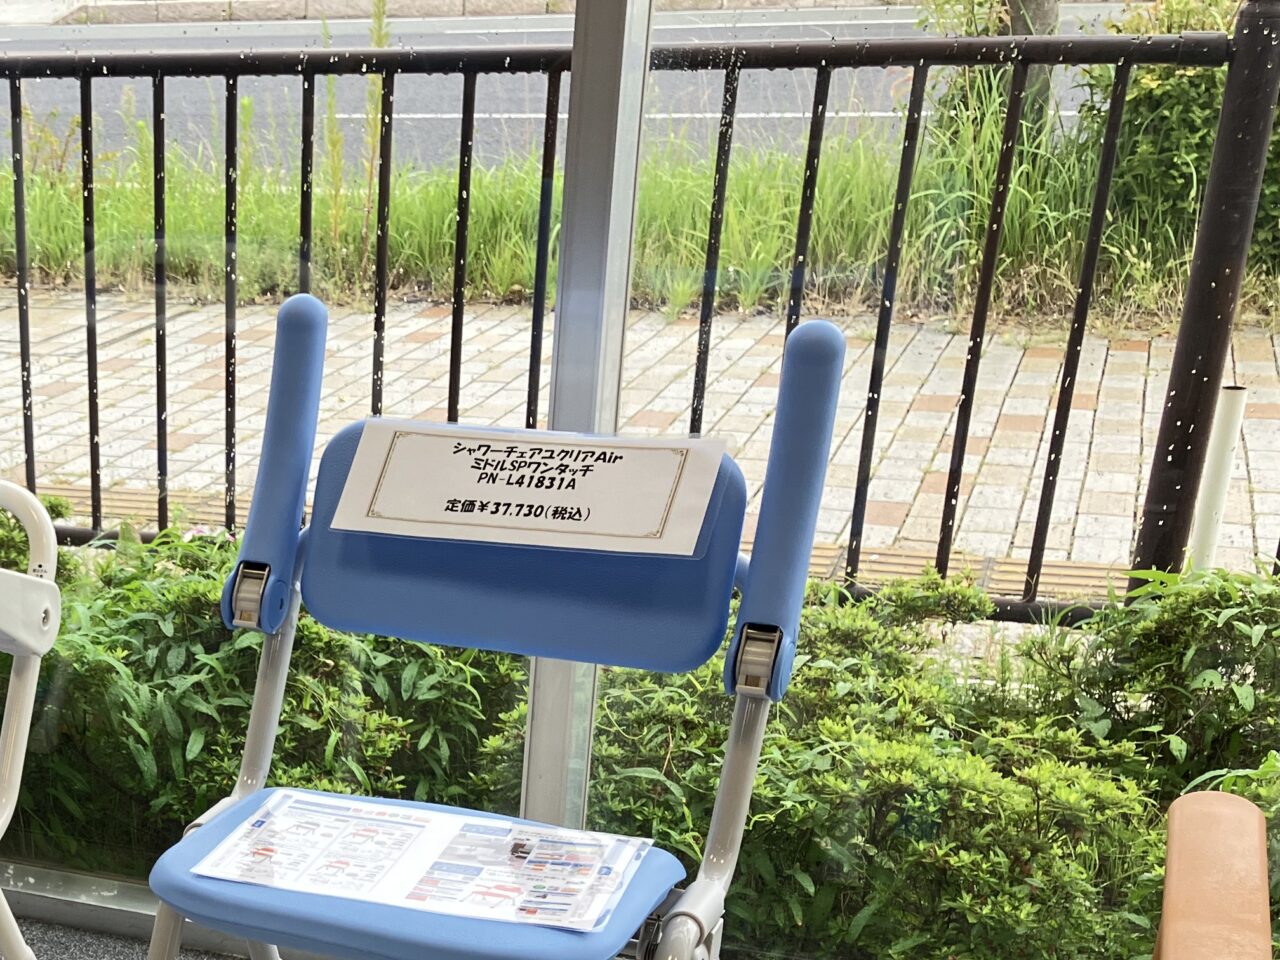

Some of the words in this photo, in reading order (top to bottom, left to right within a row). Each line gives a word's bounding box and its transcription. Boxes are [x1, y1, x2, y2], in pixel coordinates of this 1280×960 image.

[452, 442, 624, 464] シャワーチェアユクリアAir
[470, 458, 595, 477] ミドルSPワンタッチ
[477, 473, 577, 491] PN-L41831A
